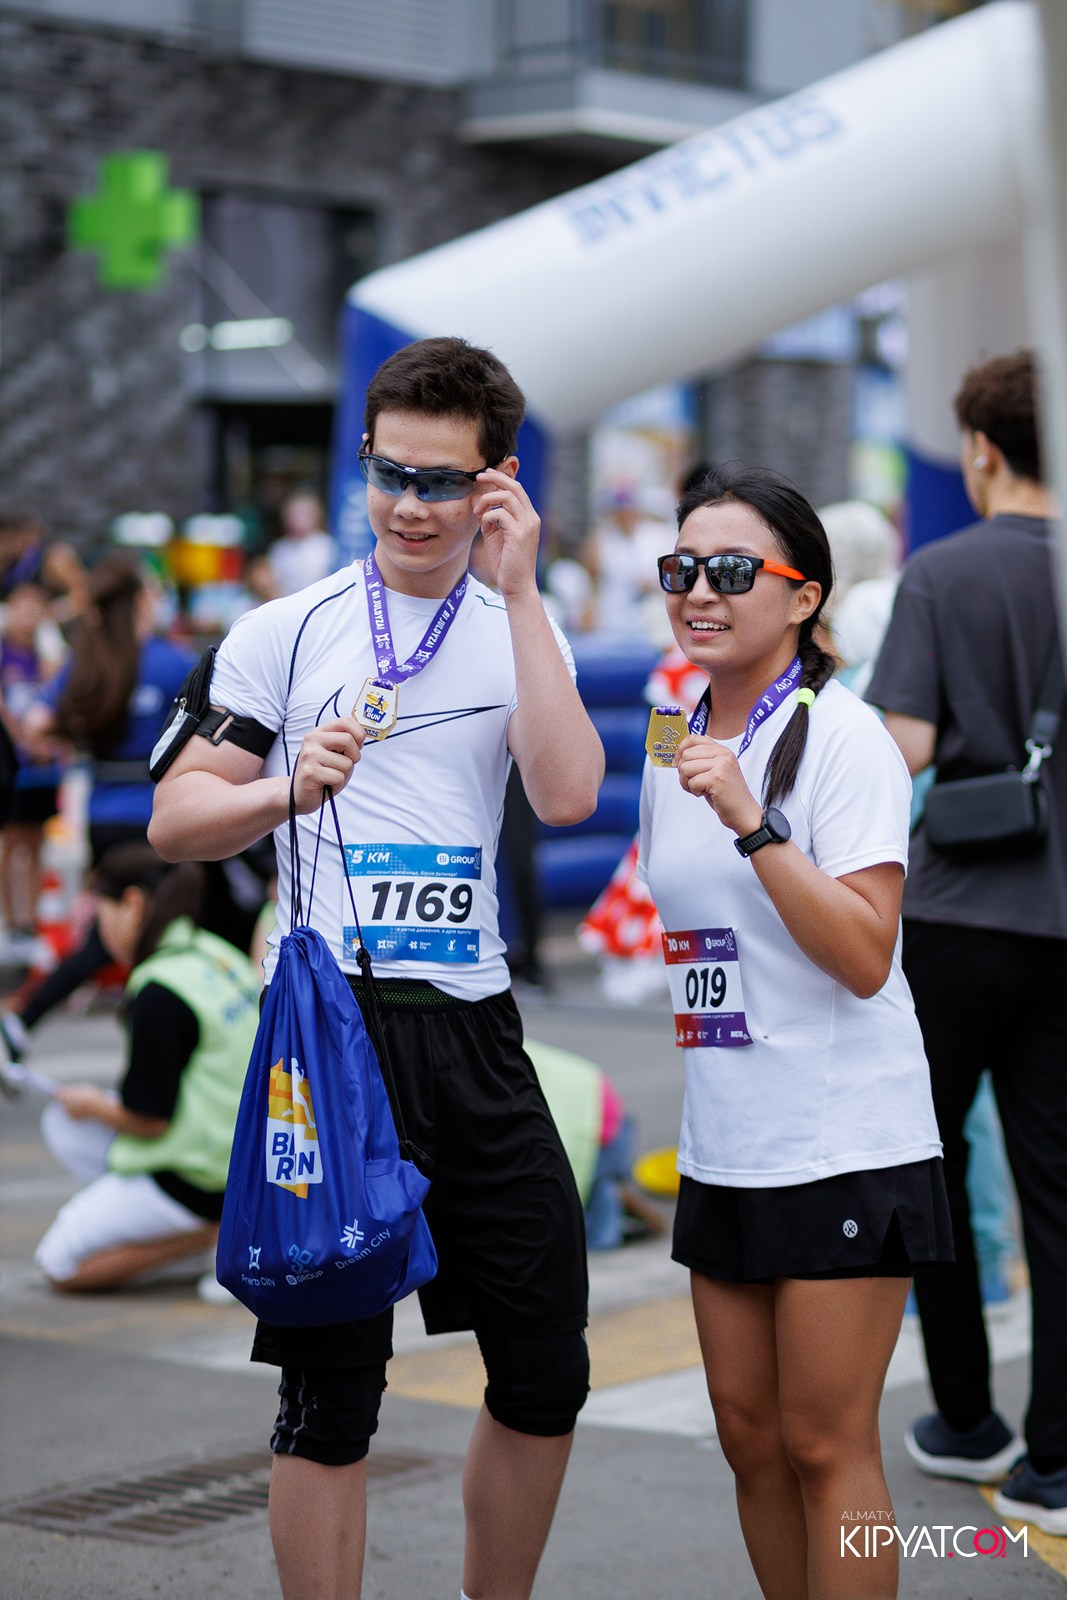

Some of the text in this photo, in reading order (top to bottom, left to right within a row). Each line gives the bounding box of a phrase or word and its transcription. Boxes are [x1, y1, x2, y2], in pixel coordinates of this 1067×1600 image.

[774, 659, 801, 693] ream City
[366, 706, 374, 714] BI
[366, 712, 382, 721] RUN
[754, 708, 765, 720] BI
[351, 850, 390, 864] 5 KM
[450, 855, 475, 865] GROUP
[371, 881, 473, 923] 1169
[668, 938, 690, 952] 10 KM
[685, 966, 727, 1009] 019
[272, 1132, 295, 1155] BI
[335, 1228, 391, 1270] Dream City
[260, 1277, 276, 1287] City
[296, 1270, 324, 1283] GROUP
